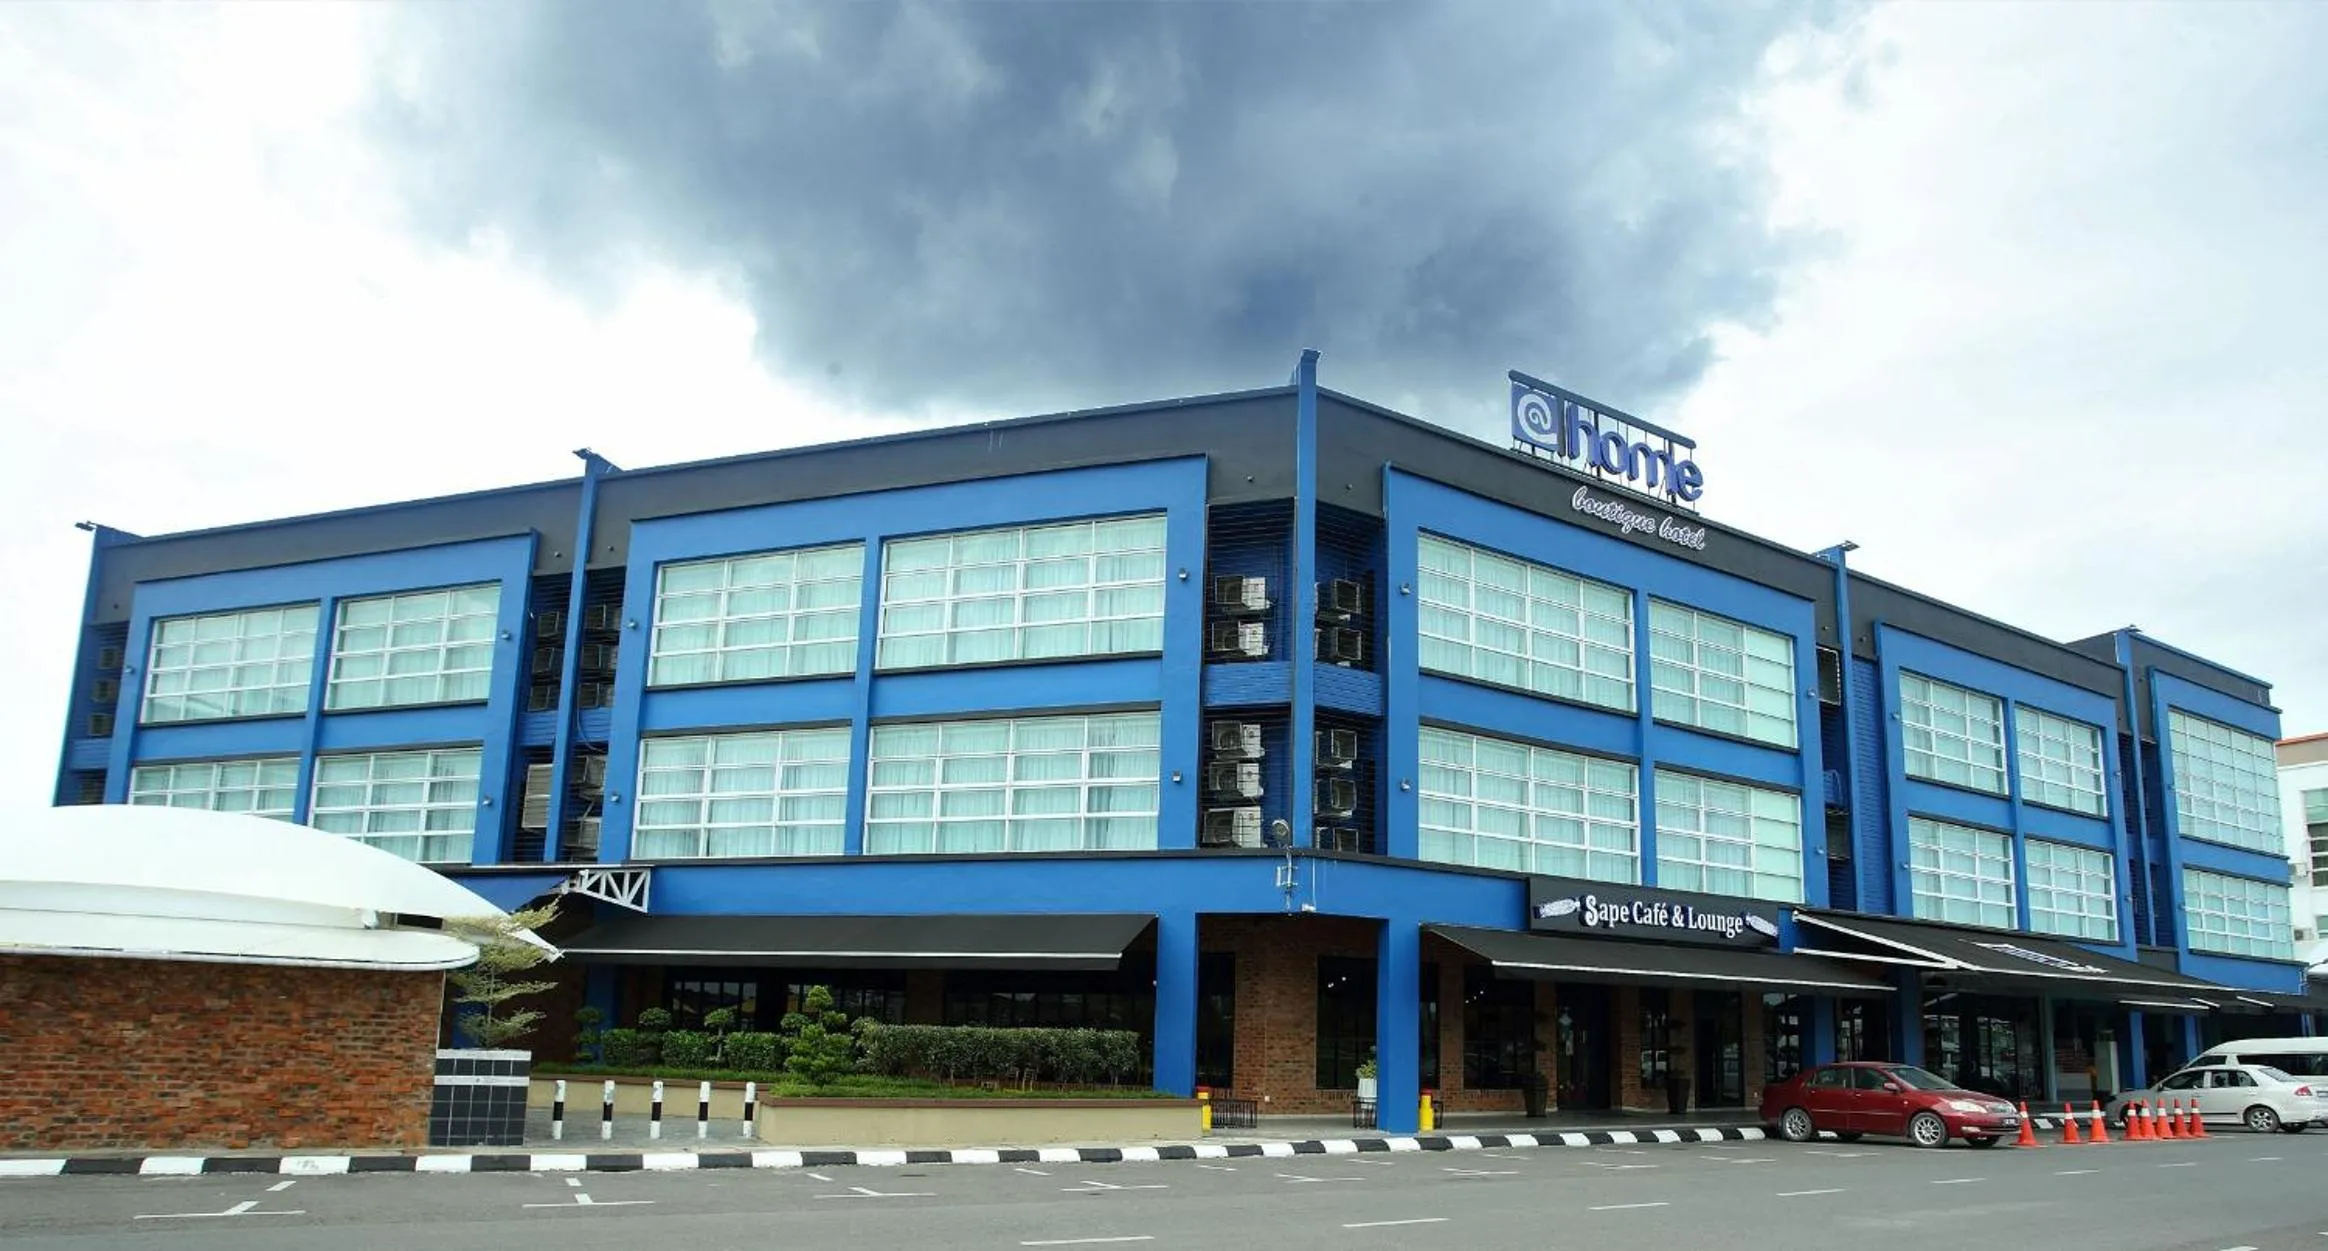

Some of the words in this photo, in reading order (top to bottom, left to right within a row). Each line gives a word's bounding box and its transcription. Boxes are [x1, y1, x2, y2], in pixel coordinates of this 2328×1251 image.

[1572, 486, 1655, 533] boutique
[1659, 516, 1706, 550] hotel
[1585, 895, 1629, 928] Sape
[1632, 900, 1667, 926] Café
[1672, 905, 1685, 927] &
[1688, 906, 1743, 938] Lounge
